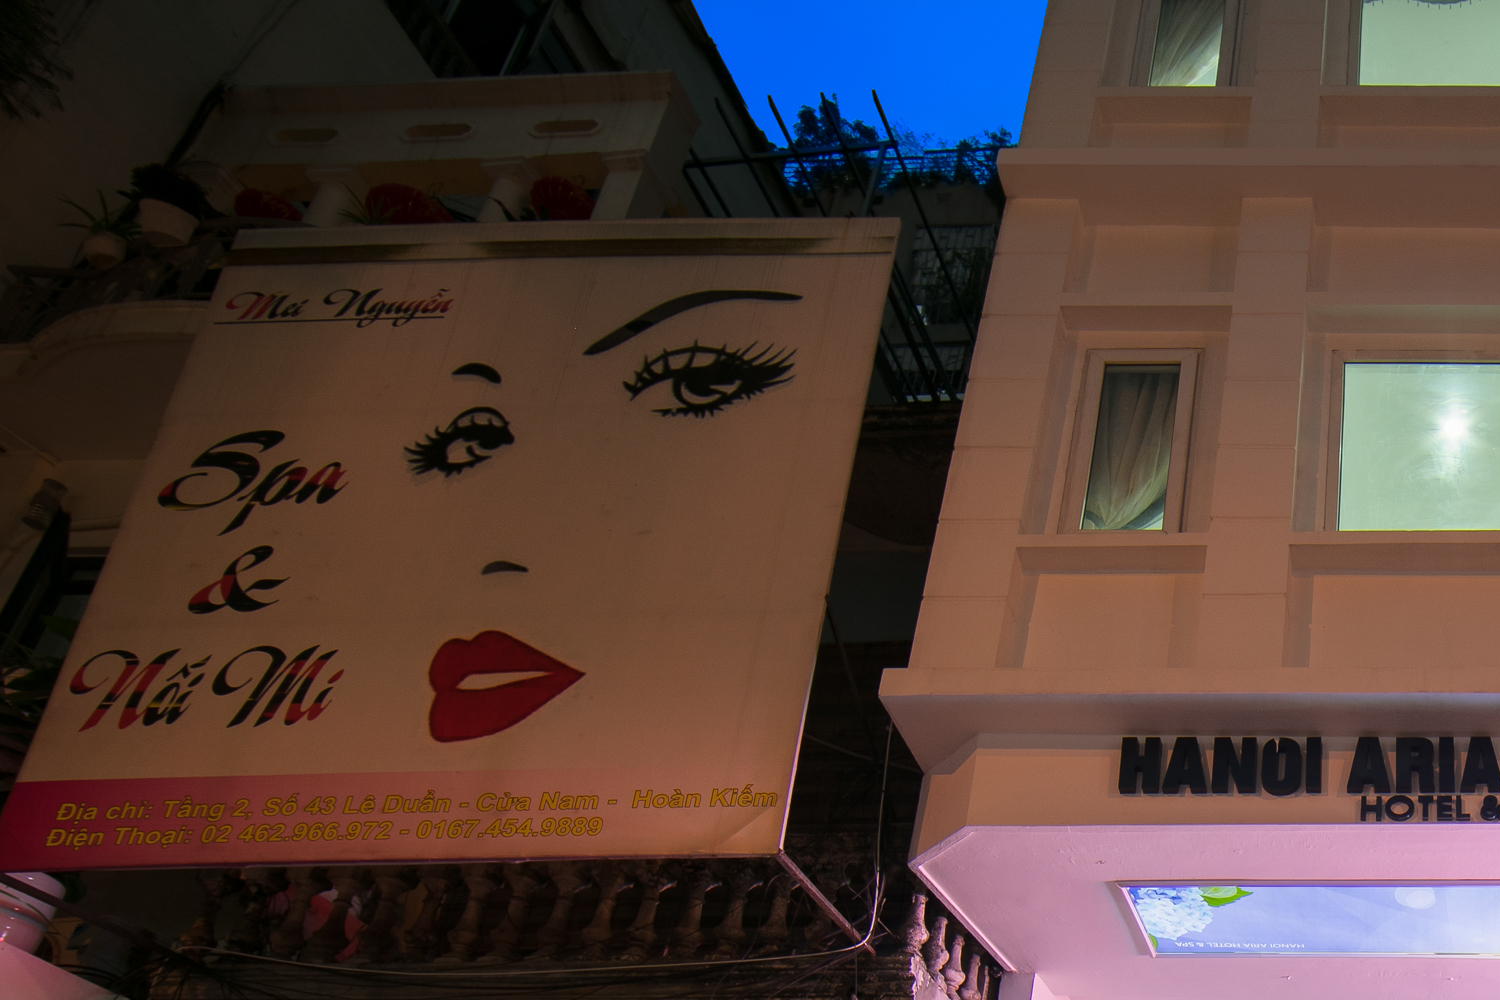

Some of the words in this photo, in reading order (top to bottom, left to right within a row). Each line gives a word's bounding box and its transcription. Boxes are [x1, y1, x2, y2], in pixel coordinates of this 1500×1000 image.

[322, 288, 454, 328] Nguyễn
[157, 429, 349, 536] Spa
[187, 545, 290, 614] &
[69, 648, 212, 732] Nối
[211, 644, 345, 728] Mi
[1117, 736, 1322, 796] HANOI
[56, 802, 101, 826] Địa
[105, 800, 151, 820] chỉ:
[163, 795, 226, 822] Tầng
[231, 798, 253, 820] 2,
[262, 792, 299, 816] Số
[303, 796, 335, 815] 43
[342, 795, 376, 814] Lê
[382, 789, 450, 813] Duẩn
[476, 791, 531, 812] Cửa
[538, 792, 599, 811] Nam
[631, 789, 702, 809] Hoàn
[709, 784, 778, 808] Kiếm
[1359, 794, 1470, 822] HOTEL
[46, 827, 104, 851] Điện
[114, 826, 193, 848] Thoại:
[200, 825, 232, 844] 02
[237, 821, 391, 843] 462.966.972
[416, 817, 603, 839] 0167.454.9889
